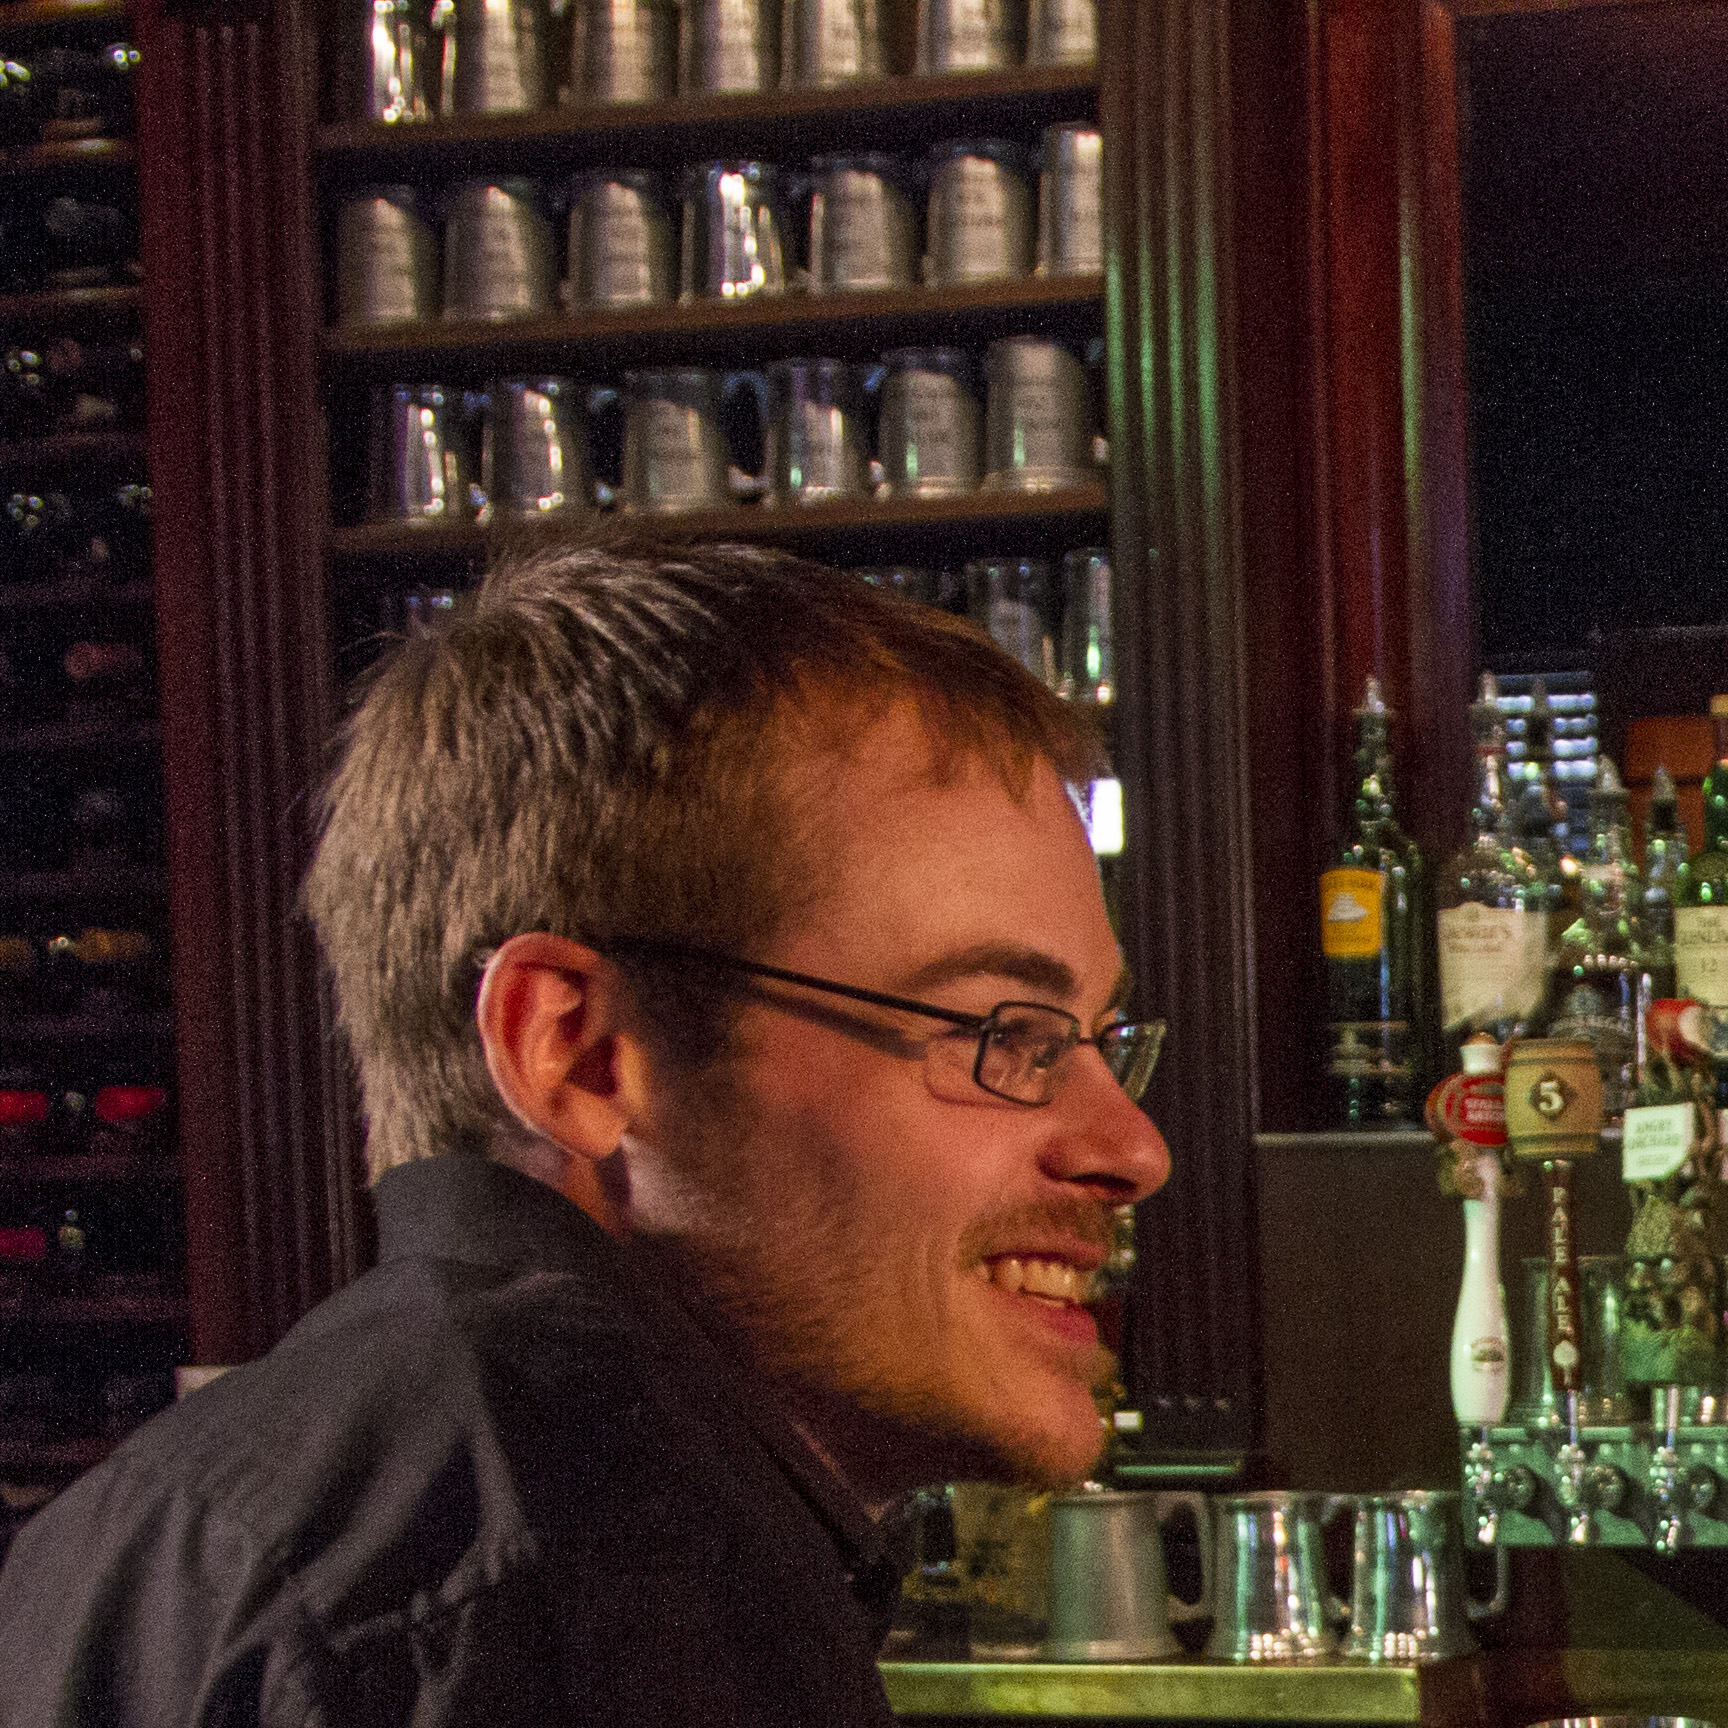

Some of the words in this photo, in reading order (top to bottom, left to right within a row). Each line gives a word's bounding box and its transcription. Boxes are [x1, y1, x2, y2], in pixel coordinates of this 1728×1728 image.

[1538, 1080, 1565, 1113] 5
[1551, 1186, 1568, 1264] PALE
[1551, 1280, 1571, 1332] ALE
